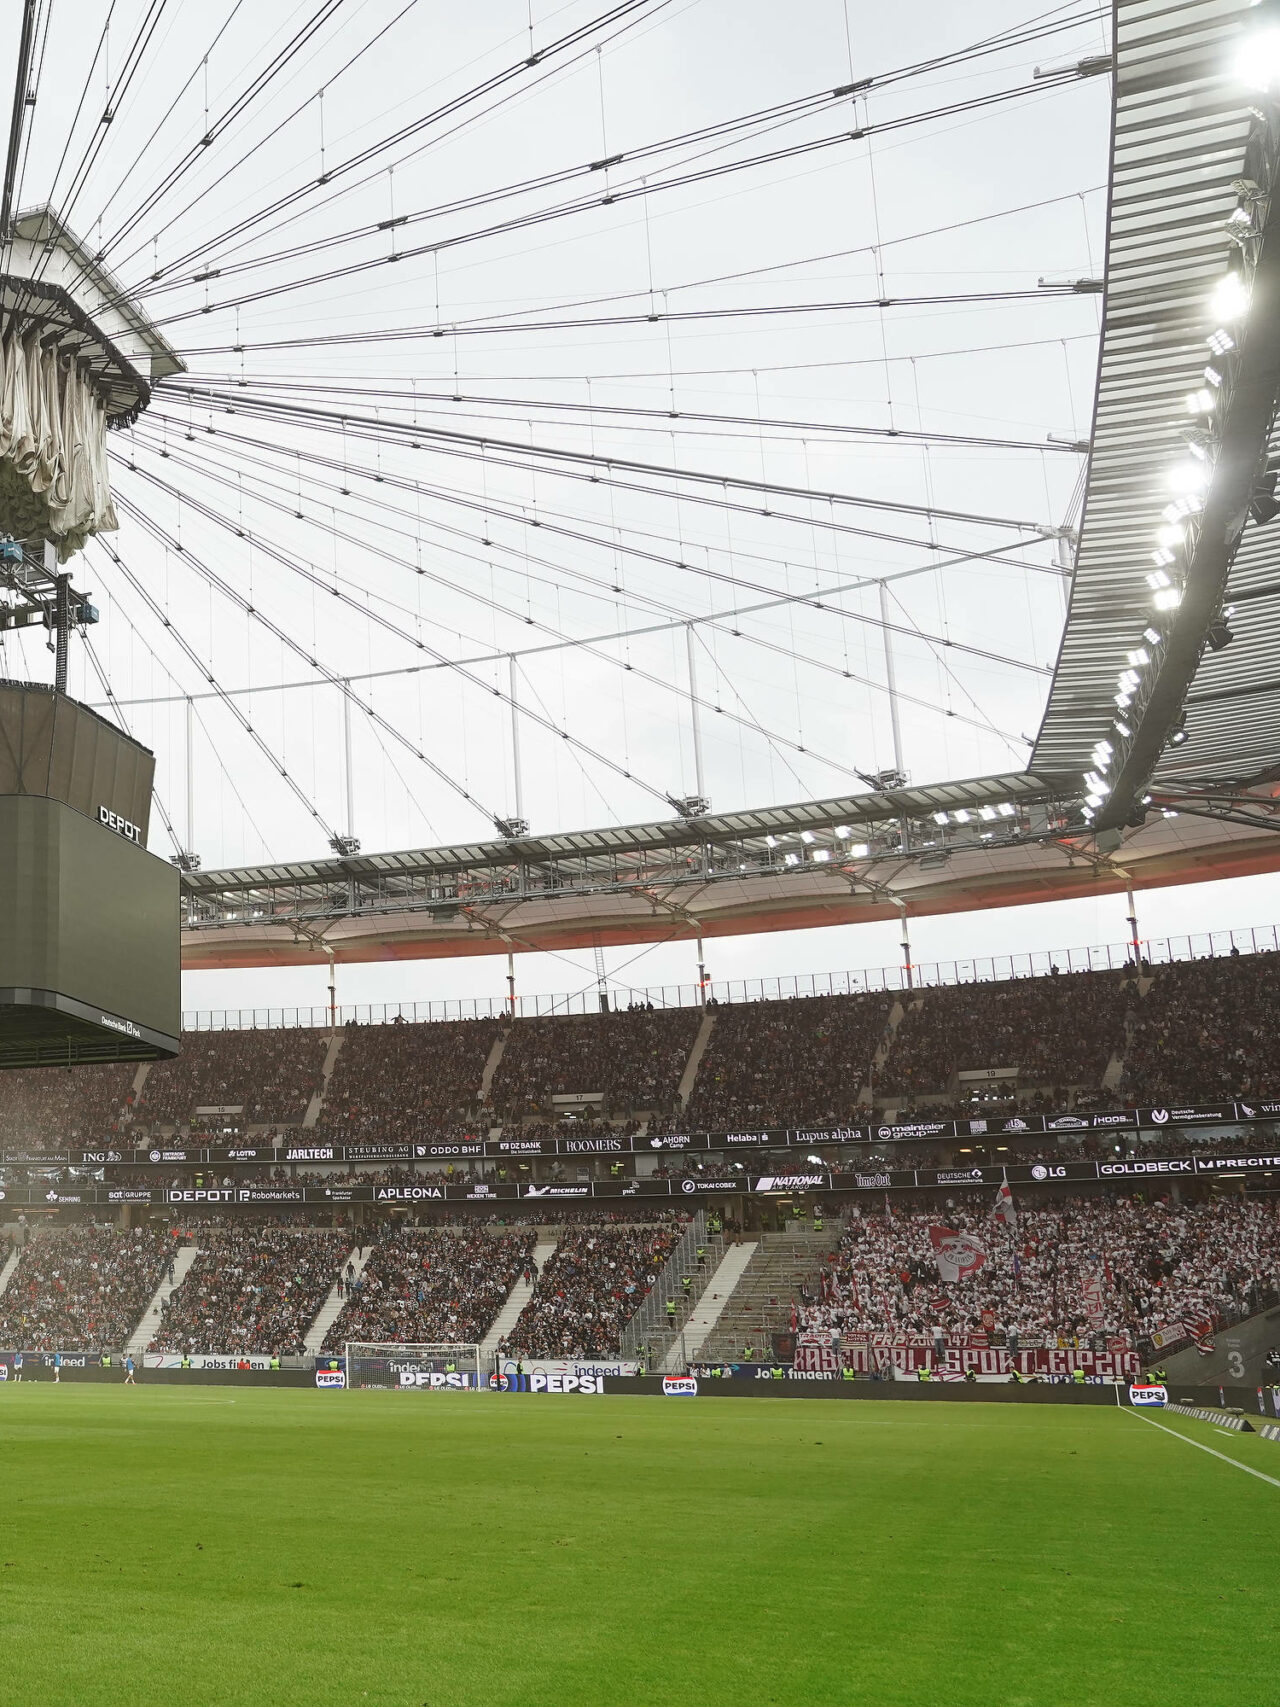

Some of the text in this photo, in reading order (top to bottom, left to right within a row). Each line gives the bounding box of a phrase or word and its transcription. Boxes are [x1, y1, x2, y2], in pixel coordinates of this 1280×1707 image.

[99, 805, 141, 844] DEPOT
[101, 1016, 141, 1037] Deutsche Bank Park
[891, 1123, 946, 1132] maintaler
[663, 1135, 690, 1144] AHORN
[727, 1133, 758, 1143] Helaba
[796, 1127, 862, 1143] Lupus alpha
[891, 1130, 927, 1139] group
[348, 1146, 395, 1154] STEUBING
[430, 1145, 482, 1155] ODDO BHF
[566, 1139, 622, 1152] ROOMERS
[82, 1152, 105, 1162] ING
[286, 1149, 333, 1160] JARLTECH
[1100, 1160, 1192, 1175] GOLDBECK
[1216, 1157, 1280, 1168] PRECITE
[937, 1172, 971, 1181] DEUTSCHE
[1049, 1166, 1067, 1177] LG
[696, 1181, 737, 1190] TOKAI COBEX
[773, 1175, 824, 1186] NATIONAL
[108, 1190, 151, 1199] sat GRUPPE
[170, 1190, 233, 1202] DEPOT
[251, 1190, 300, 1200] RoboMarkets
[378, 1187, 442, 1199] APLEONA
[549, 1187, 589, 1195] MICHELIN
[201, 1359, 264, 1369] Jobs fien
[386, 1360, 433, 1373] inde
[572, 1362, 621, 1376] indeed
[1227, 1351, 1245, 1378] 3
[754, 1367, 833, 1380] Jo finden
[317, 1375, 344, 1383] PEPSI
[529, 1375, 604, 1394] PEPSI
[664, 1381, 695, 1390] PEPSI
[1132, 1391, 1166, 1401] PEPSI
